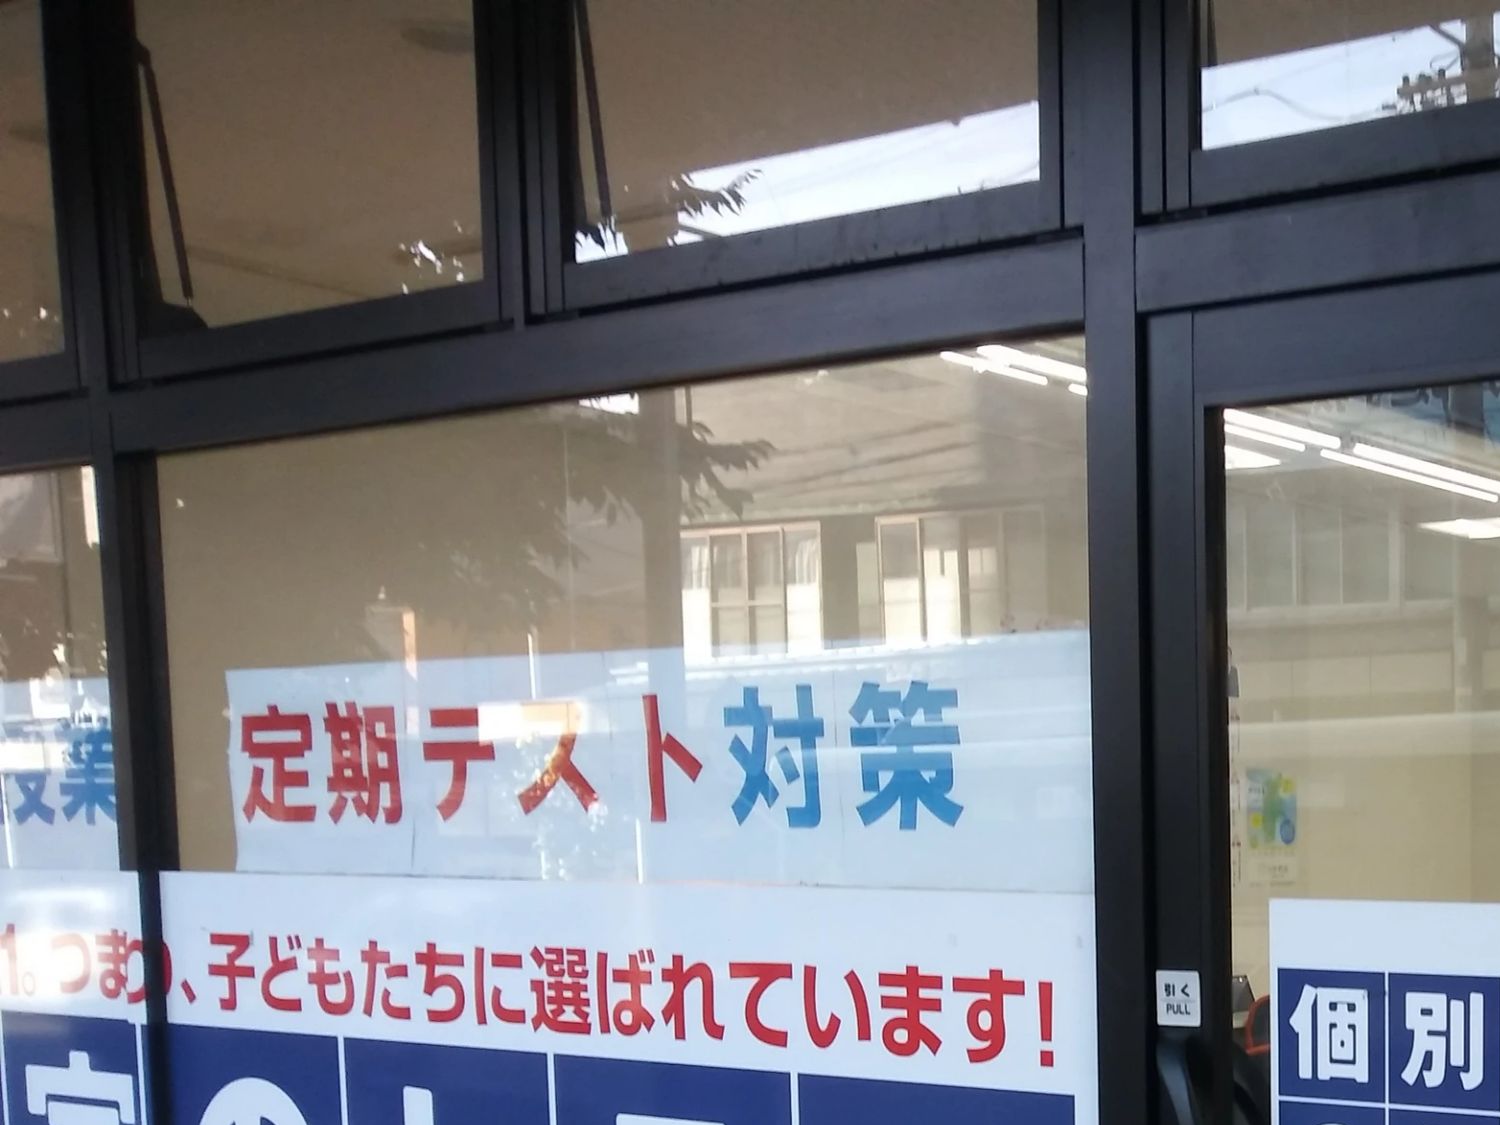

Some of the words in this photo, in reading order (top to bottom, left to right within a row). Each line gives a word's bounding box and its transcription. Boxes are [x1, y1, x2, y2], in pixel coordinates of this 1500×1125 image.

[241, 680, 964, 830] 定期テスト対策
[1166, 1002, 1191, 1016] PULL
